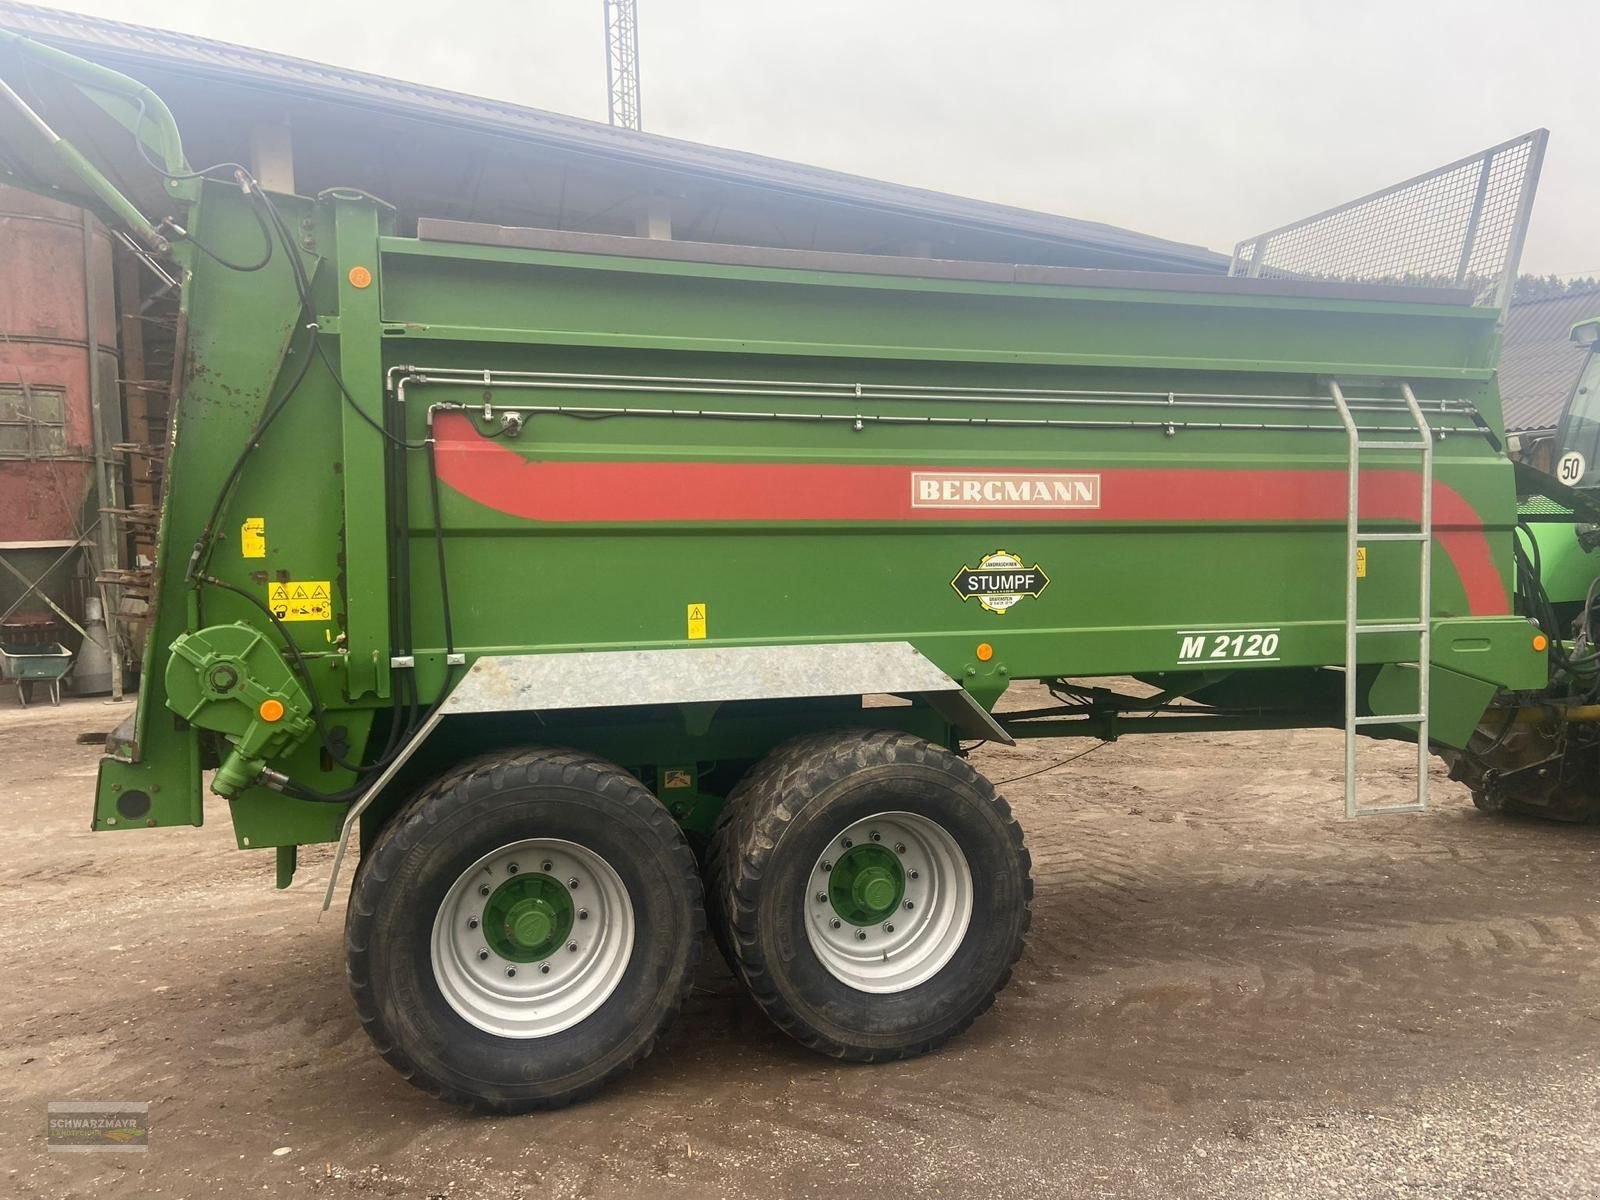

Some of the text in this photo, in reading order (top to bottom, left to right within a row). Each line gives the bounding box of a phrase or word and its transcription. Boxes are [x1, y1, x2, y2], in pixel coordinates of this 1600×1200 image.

[1562, 458, 1580, 480] 50
[919, 480, 1093, 502] BERGMANN
[967, 574, 1035, 591] STUMPF
[1179, 633, 1279, 659] M 2120
